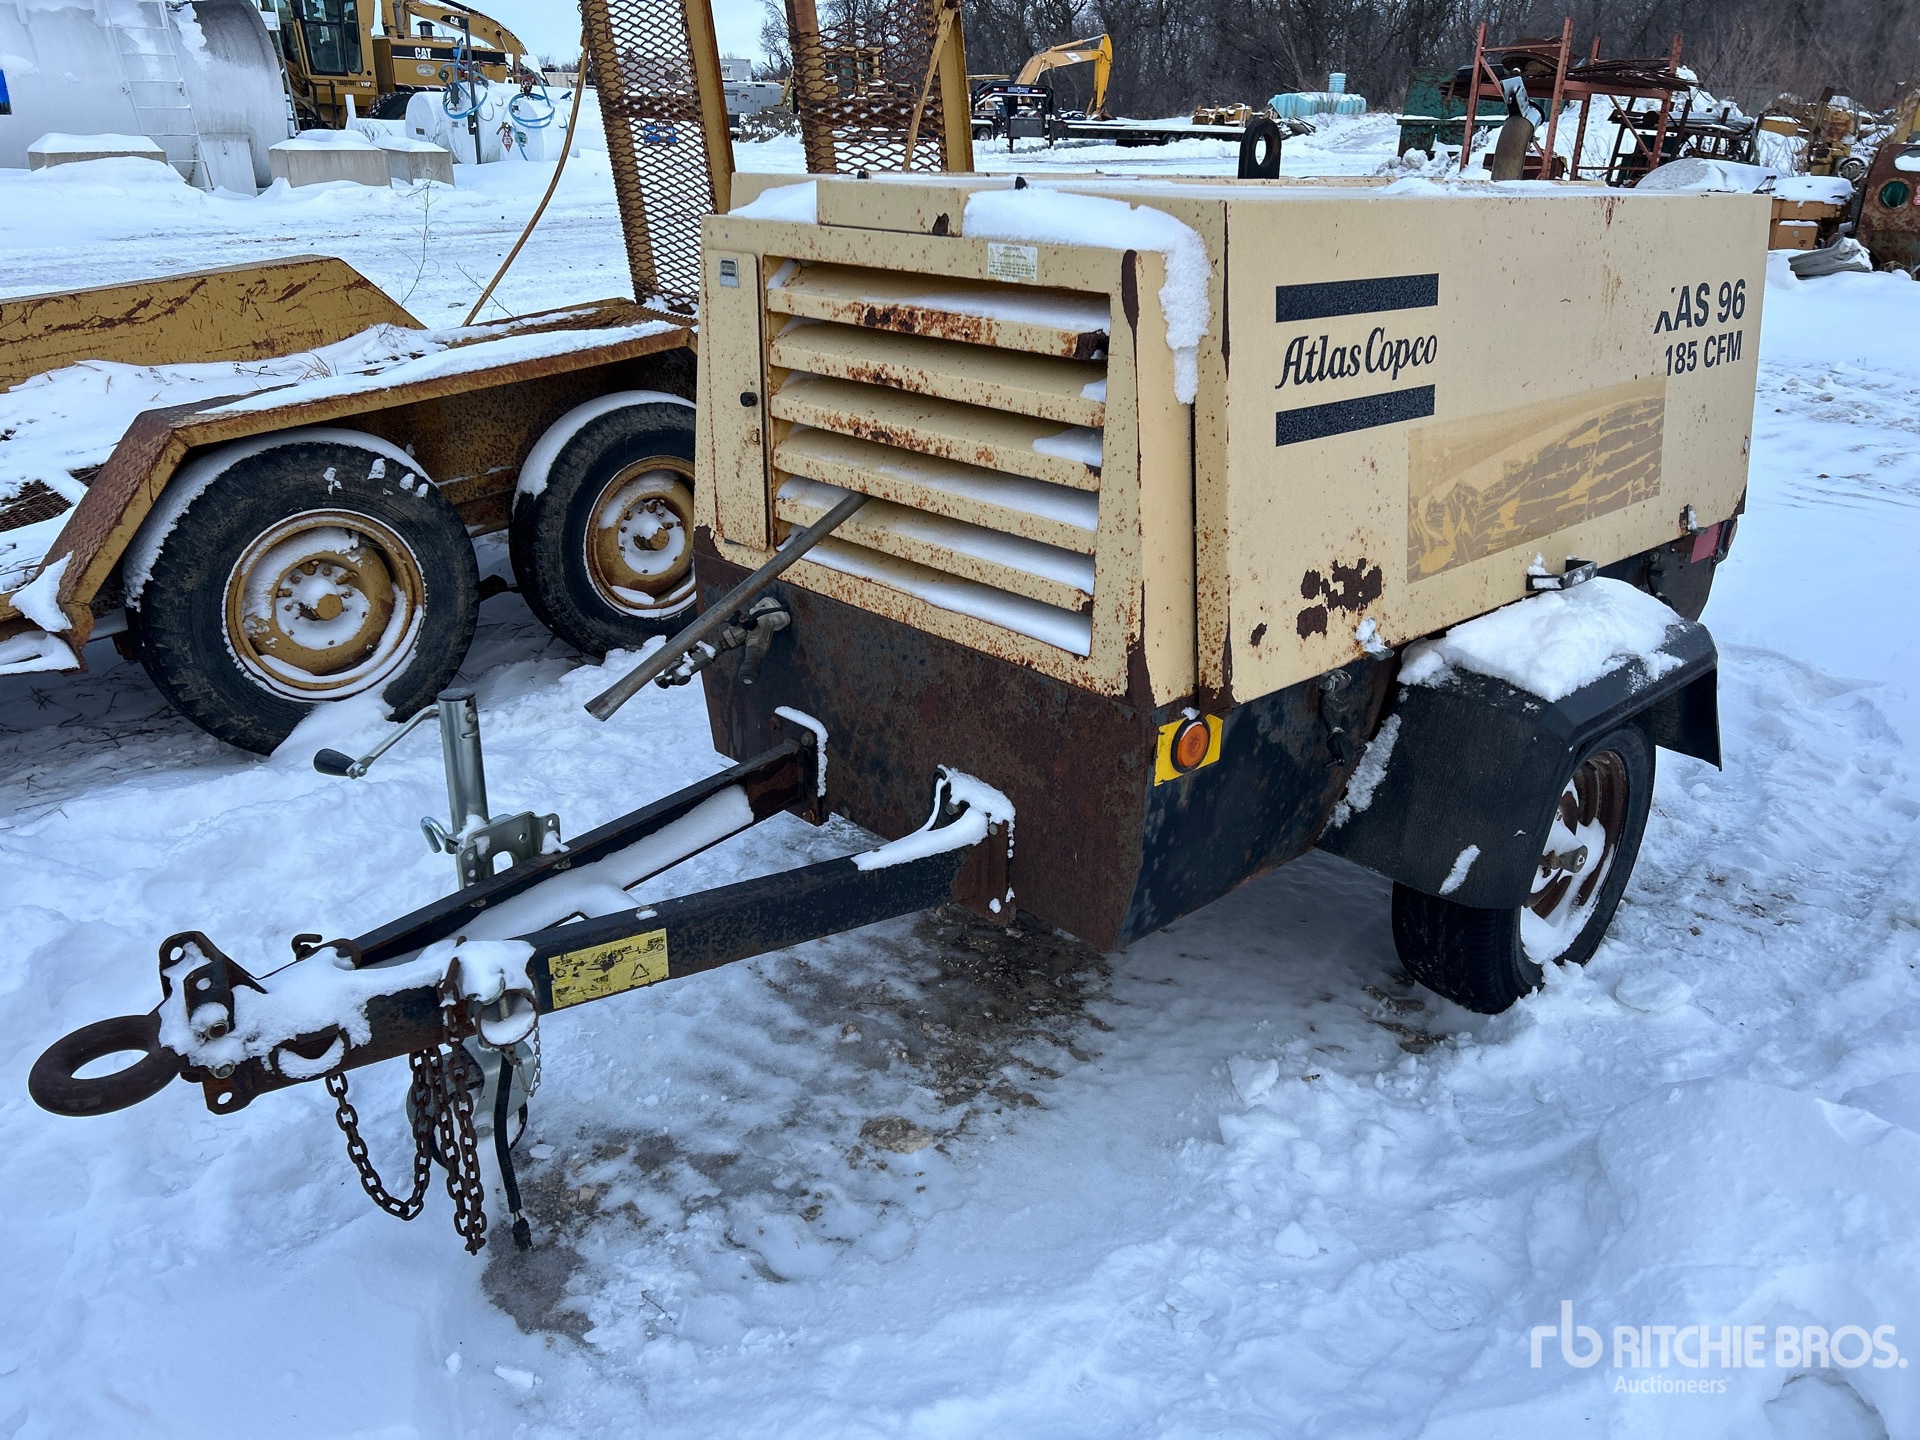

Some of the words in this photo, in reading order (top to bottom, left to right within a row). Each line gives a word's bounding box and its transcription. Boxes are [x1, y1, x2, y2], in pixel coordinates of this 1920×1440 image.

[450, 15, 460, 26] CA
[414, 47, 432, 60] CAT
[1717, 278, 1746, 323] 96
[1275, 335, 1361, 389] Atlas
[1365, 327, 1437, 380] Copco
[1665, 340, 1698, 377] 185
[1703, 330, 1743, 368] CFM
